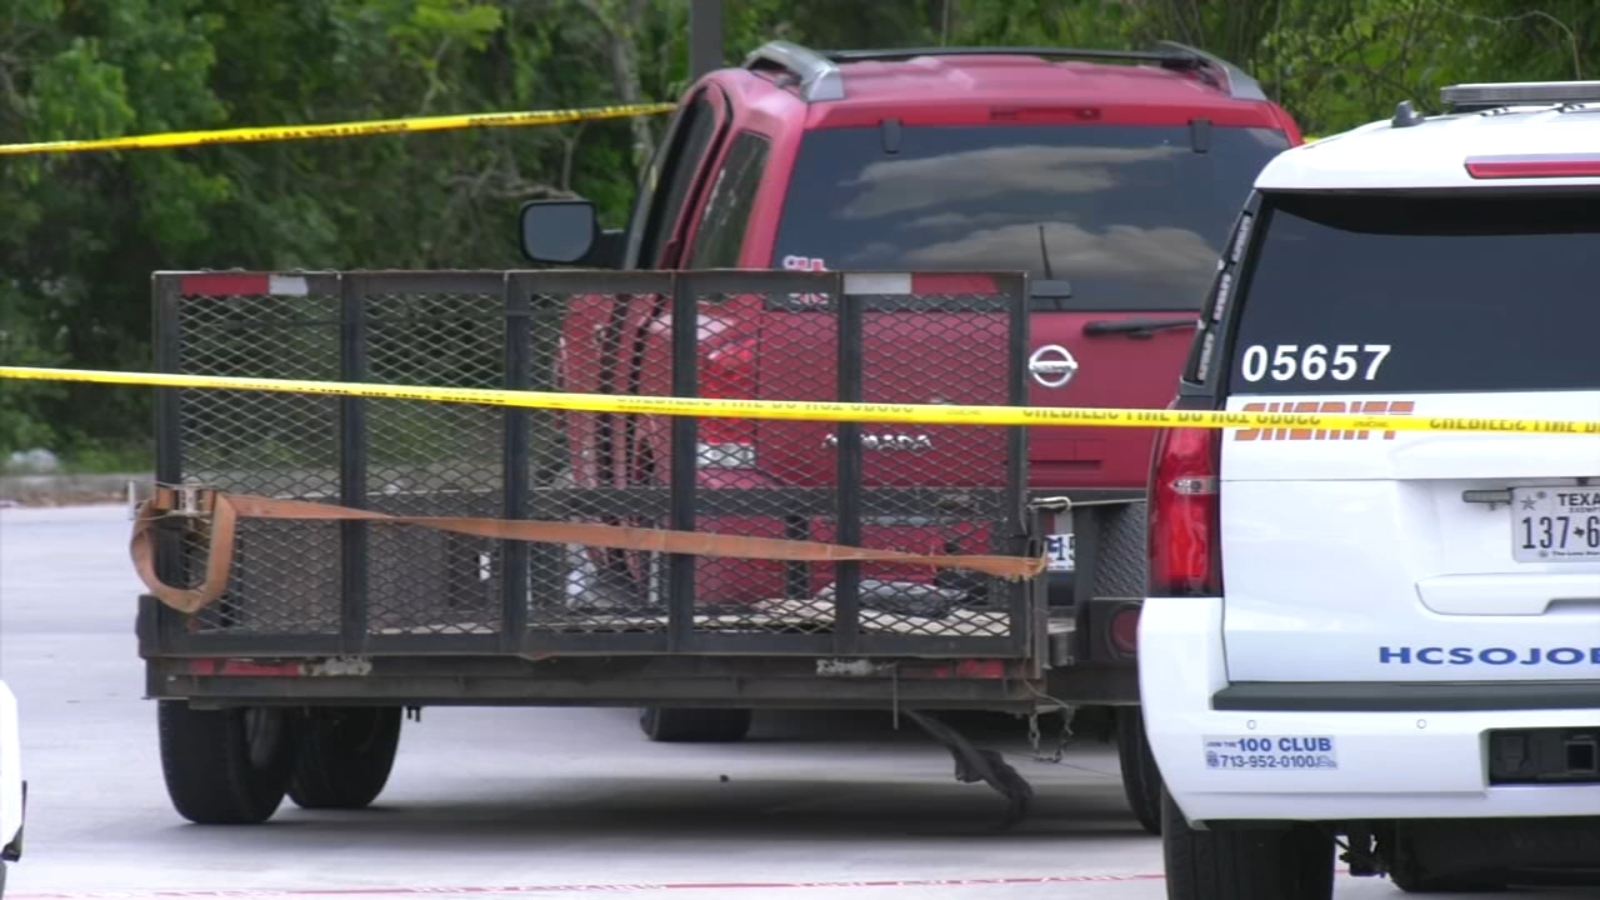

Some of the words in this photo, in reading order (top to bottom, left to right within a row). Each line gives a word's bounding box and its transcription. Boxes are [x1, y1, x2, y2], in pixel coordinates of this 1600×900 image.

[1241, 344, 1392, 382] 05657
[1238, 737, 1272, 752] 100
[1278, 737, 1332, 752] CLUB
[1219, 754, 1316, 768] 713-952-0100
